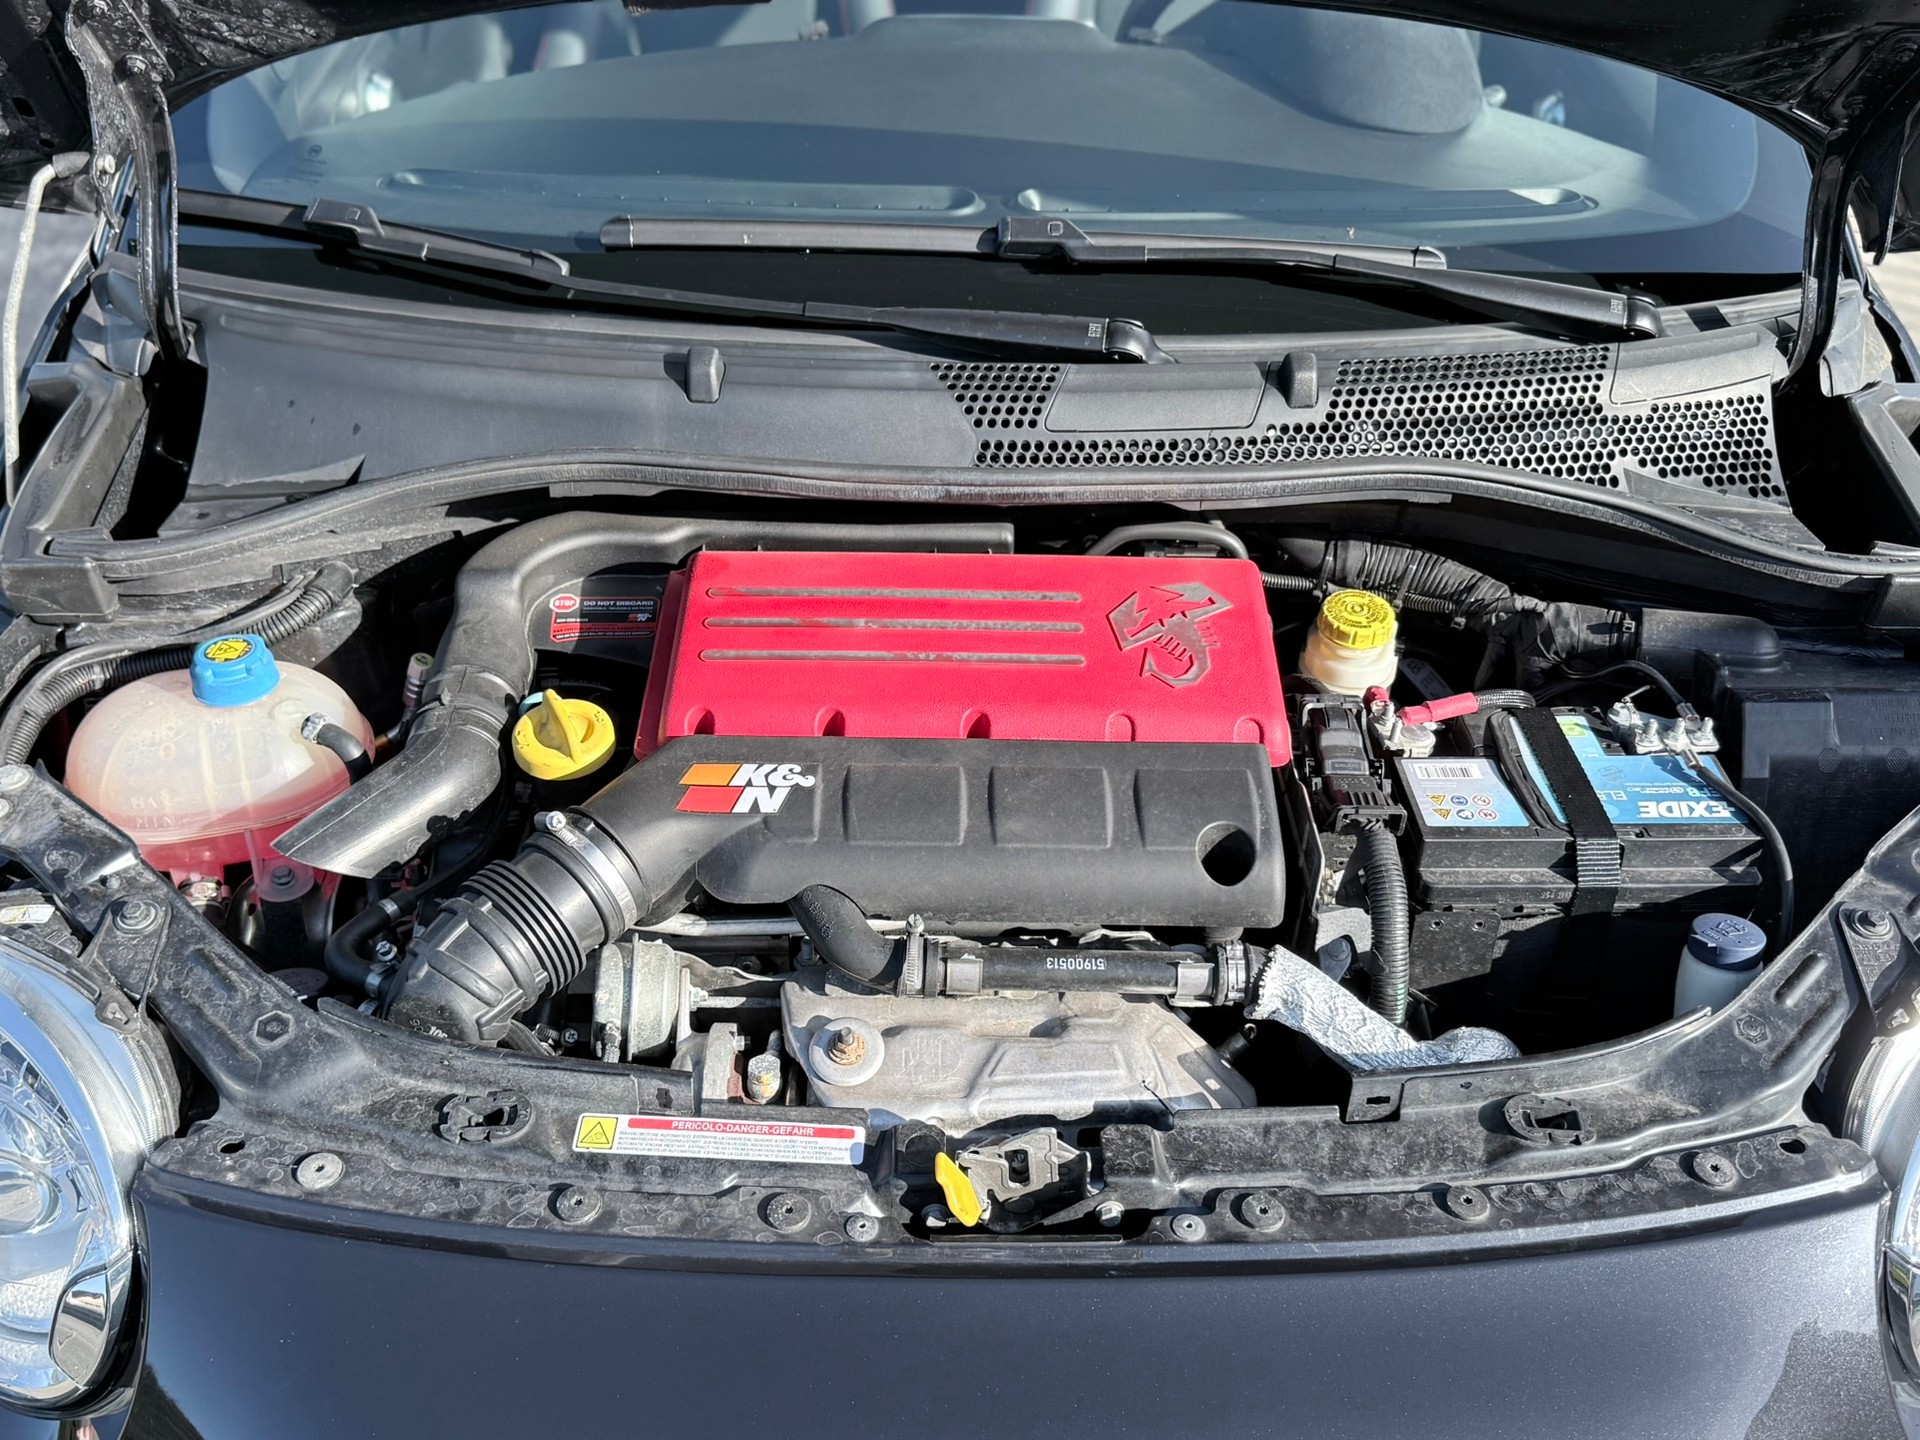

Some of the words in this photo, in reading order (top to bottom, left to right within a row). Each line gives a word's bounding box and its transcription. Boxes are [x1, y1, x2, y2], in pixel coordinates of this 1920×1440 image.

[554, 599, 575, 607] STOP
[1637, 800, 1735, 818] EXIDE
[1046, 957, 1106, 970] 51900513
[671, 1121, 814, 1136] PERICOLO-DANGER-GEFAHR
